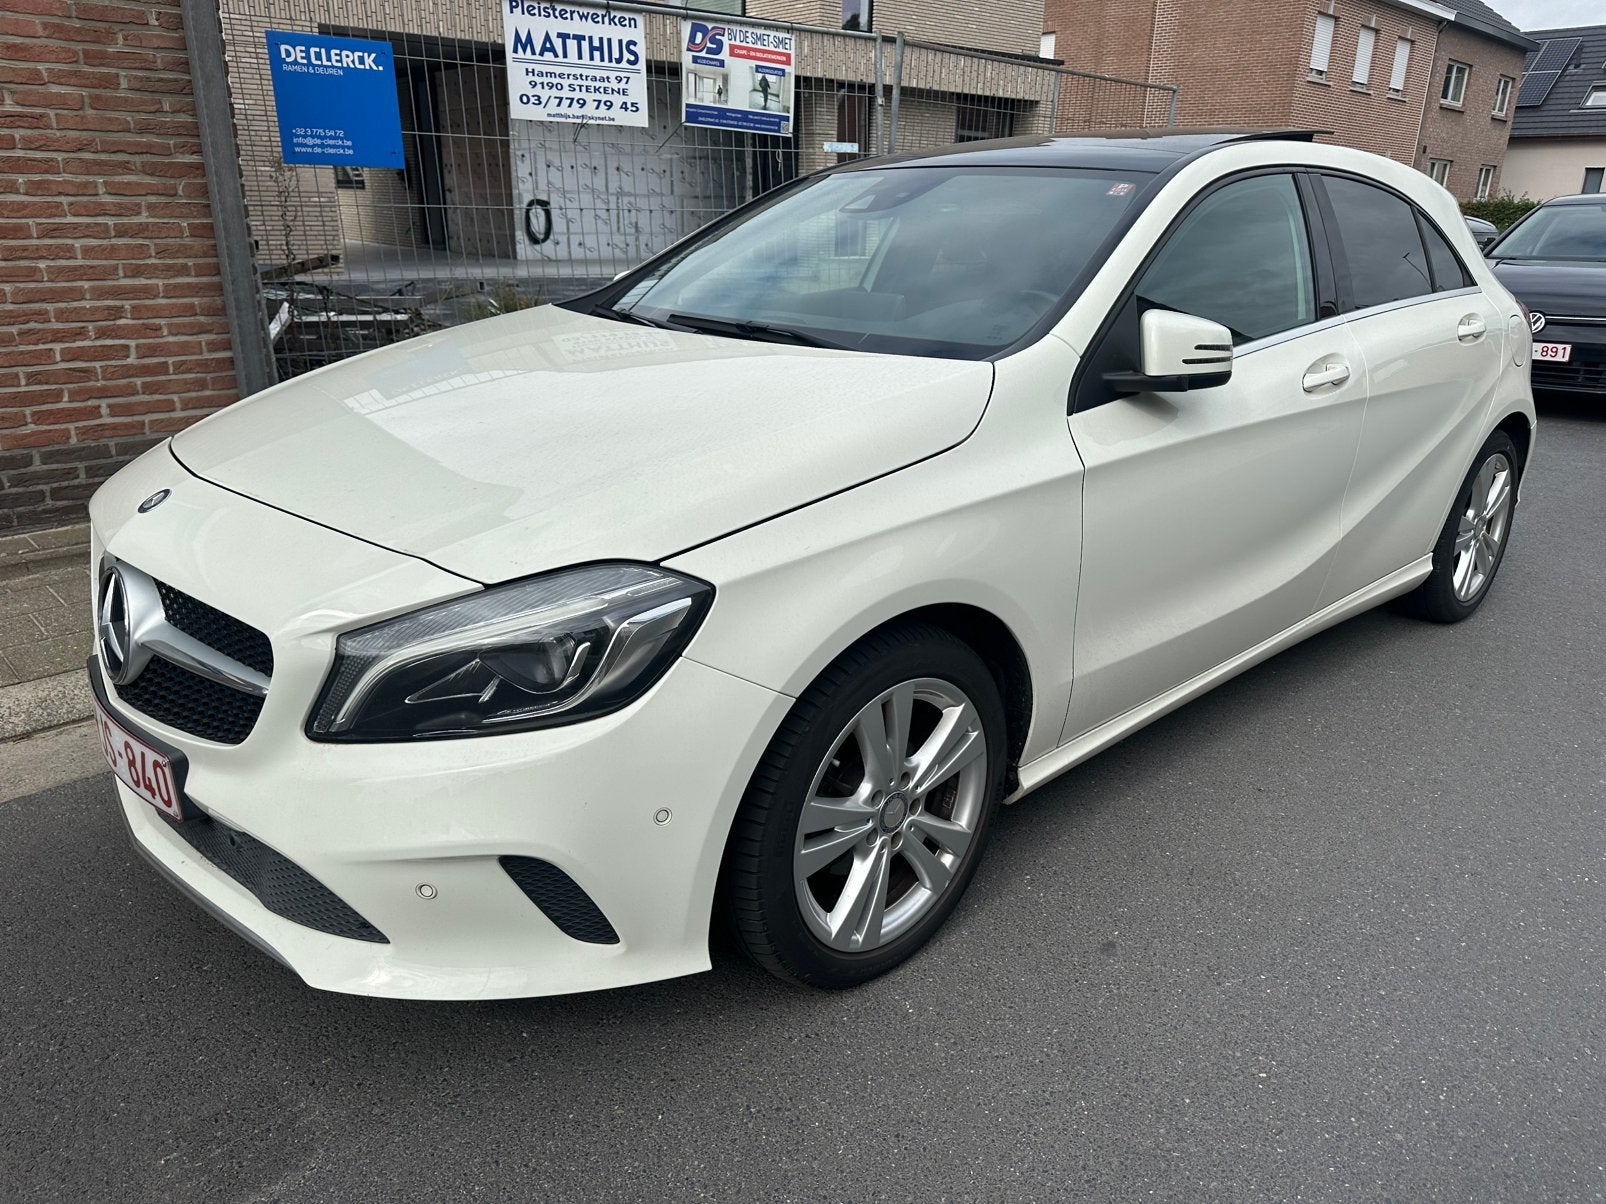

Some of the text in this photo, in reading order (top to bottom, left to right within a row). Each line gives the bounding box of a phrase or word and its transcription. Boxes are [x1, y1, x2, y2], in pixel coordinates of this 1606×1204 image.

[509, 0, 638, 29] Pleisterwerken
[511, 26, 640, 66] MATTHIJS
[686, 22, 726, 56] DS
[727, 27, 792, 51] BV DE SMET-SMET
[280, 44, 384, 71] DE CLERCK.
[282, 64, 308, 73] RAMEN
[315, 66, 344, 76] DEUREN
[525, 67, 631, 85] Hamerstraat 97
[528, 80, 630, 96] 9190 STEKENE
[519, 93, 640, 113] 03/779 79 45
[293, 136, 353, 146] info@de-clerck.be
[311, 128, 325, 136] 775
[294, 146, 354, 155] www.de-clerck.be
